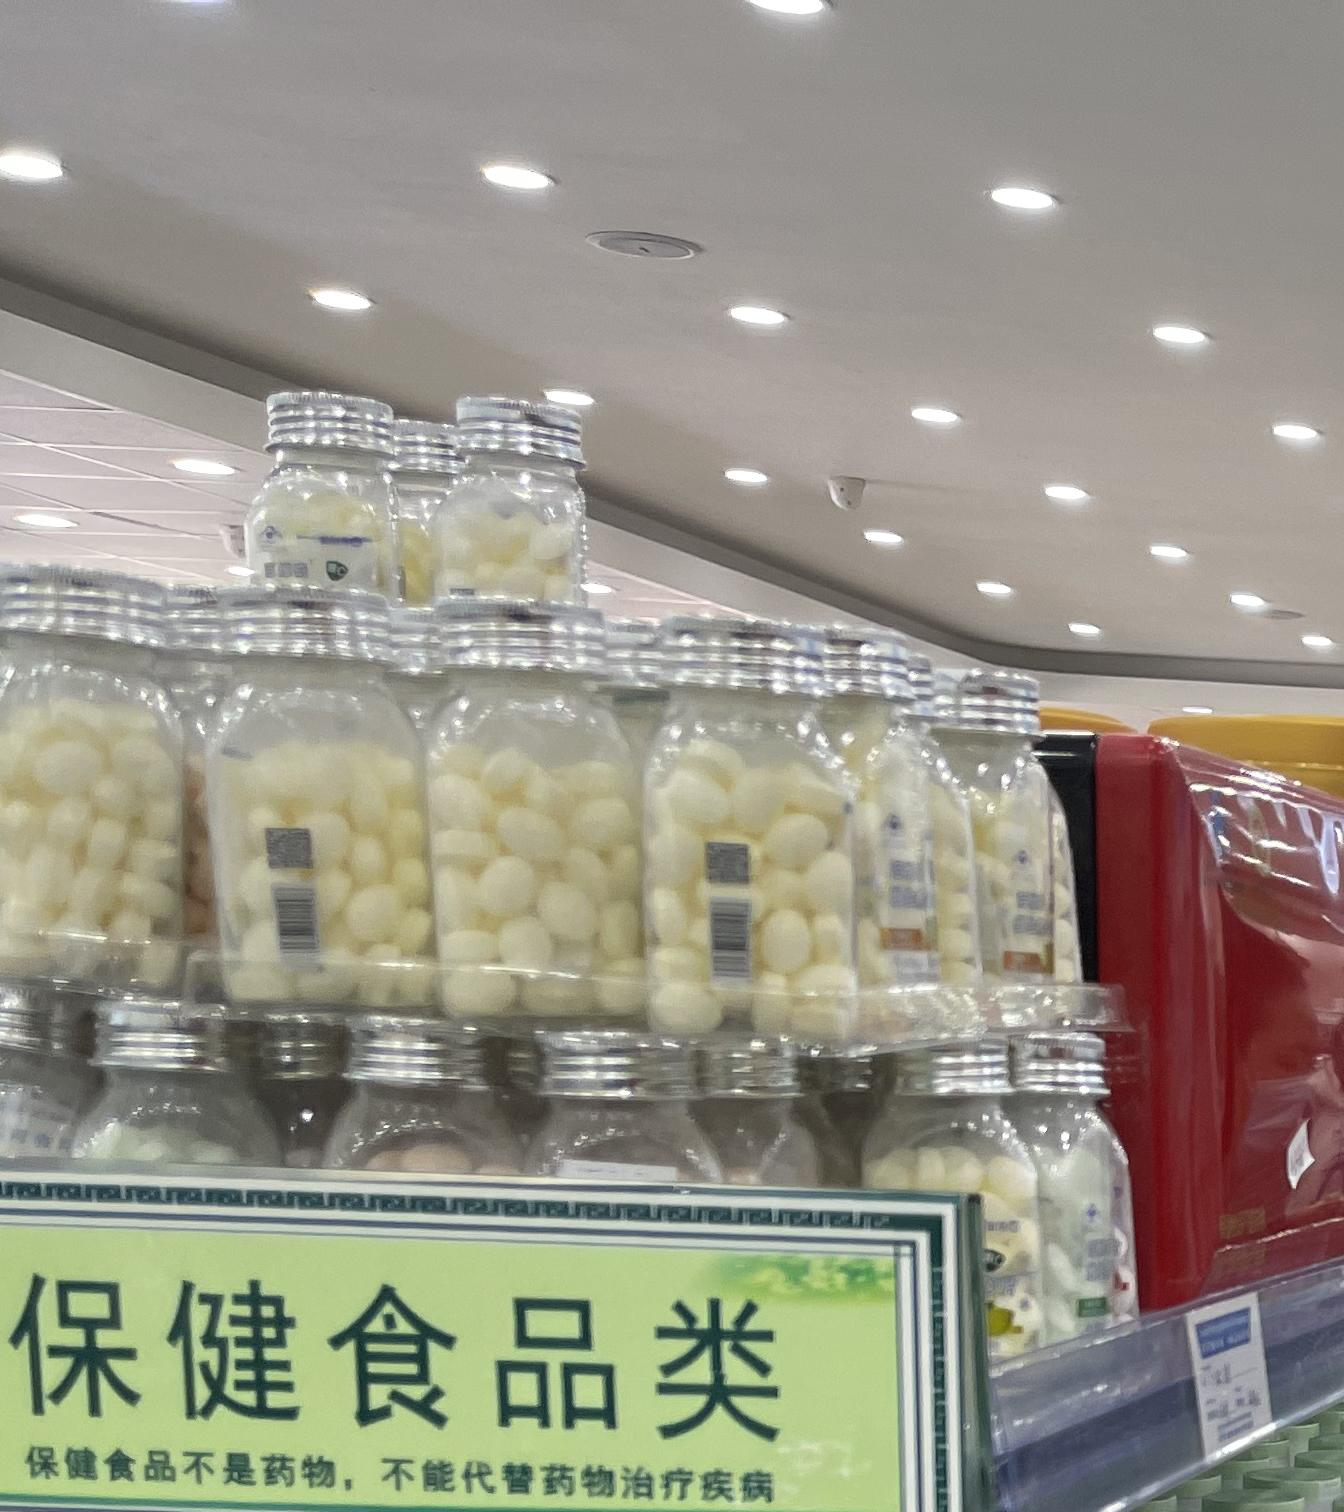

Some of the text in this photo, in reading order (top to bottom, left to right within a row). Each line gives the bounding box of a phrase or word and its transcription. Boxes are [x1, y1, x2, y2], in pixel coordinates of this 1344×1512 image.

[9, 1271, 781, 1441] 保健食品类
[25, 1446, 775, 1504] 保健食品不是药物，不能代替药物治疗疾病
